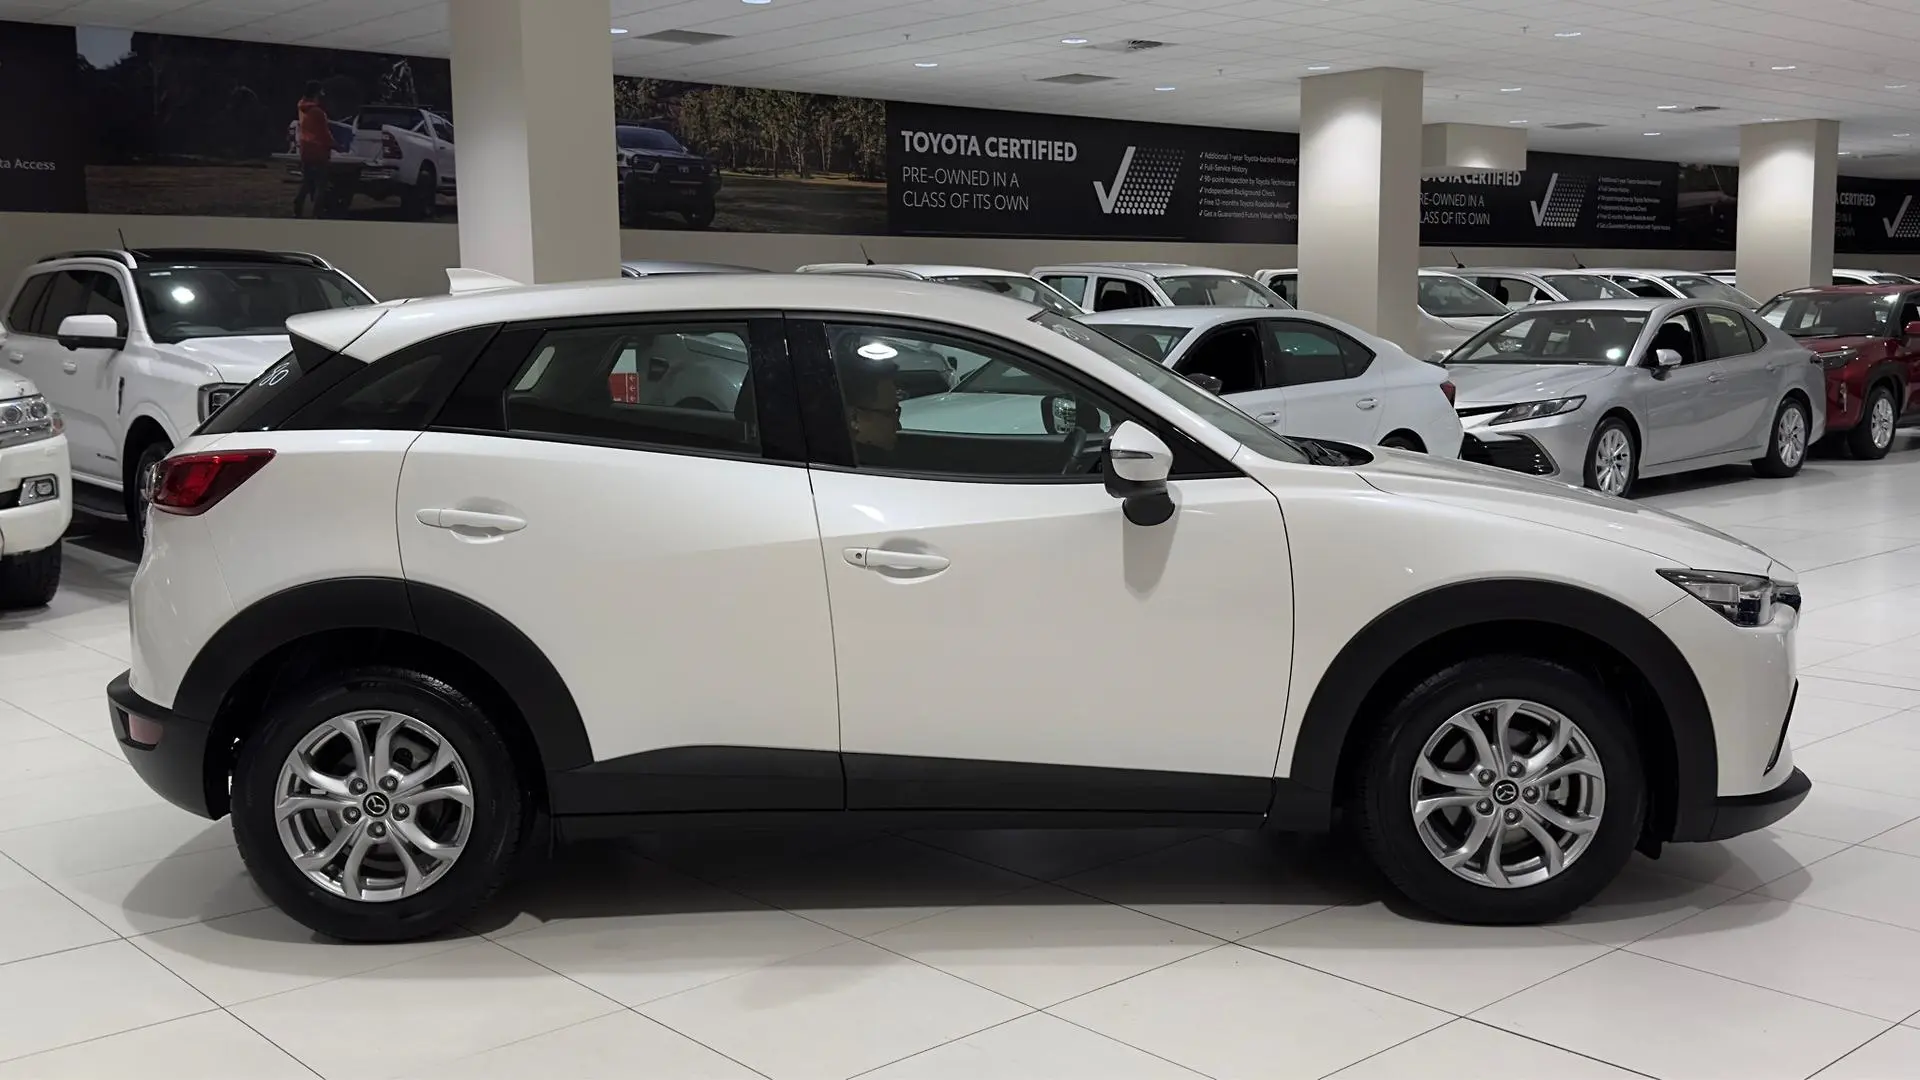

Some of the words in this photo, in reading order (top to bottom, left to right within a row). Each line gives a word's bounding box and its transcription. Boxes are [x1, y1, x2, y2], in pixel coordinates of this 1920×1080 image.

[901, 130, 981, 156] TOYOTA
[984, 136, 1078, 162] CERTIFIED
[14, 158, 56, 171] Access
[1231, 165, 1248, 174] History
[902, 166, 990, 186] PRE-OWNED
[993, 171, 1007, 187] IN
[1009, 172, 1020, 188] A
[902, 190, 946, 208] CLASS
[949, 192, 970, 209] OF
[973, 193, 991, 210] ITS
[994, 194, 1029, 211] OWN
[1419, 192, 1466, 207] RE-OWNED
[1467, 194, 1477, 207] IN
[1479, 195, 1485, 207] A
[1839, 192, 1876, 207] CERTIFIED
[1419, 211, 1439, 224] LASS
[1441, 211, 1454, 224] OF
[1455, 212, 1467, 225] ITS
[1468, 212, 1491, 225] OWN
